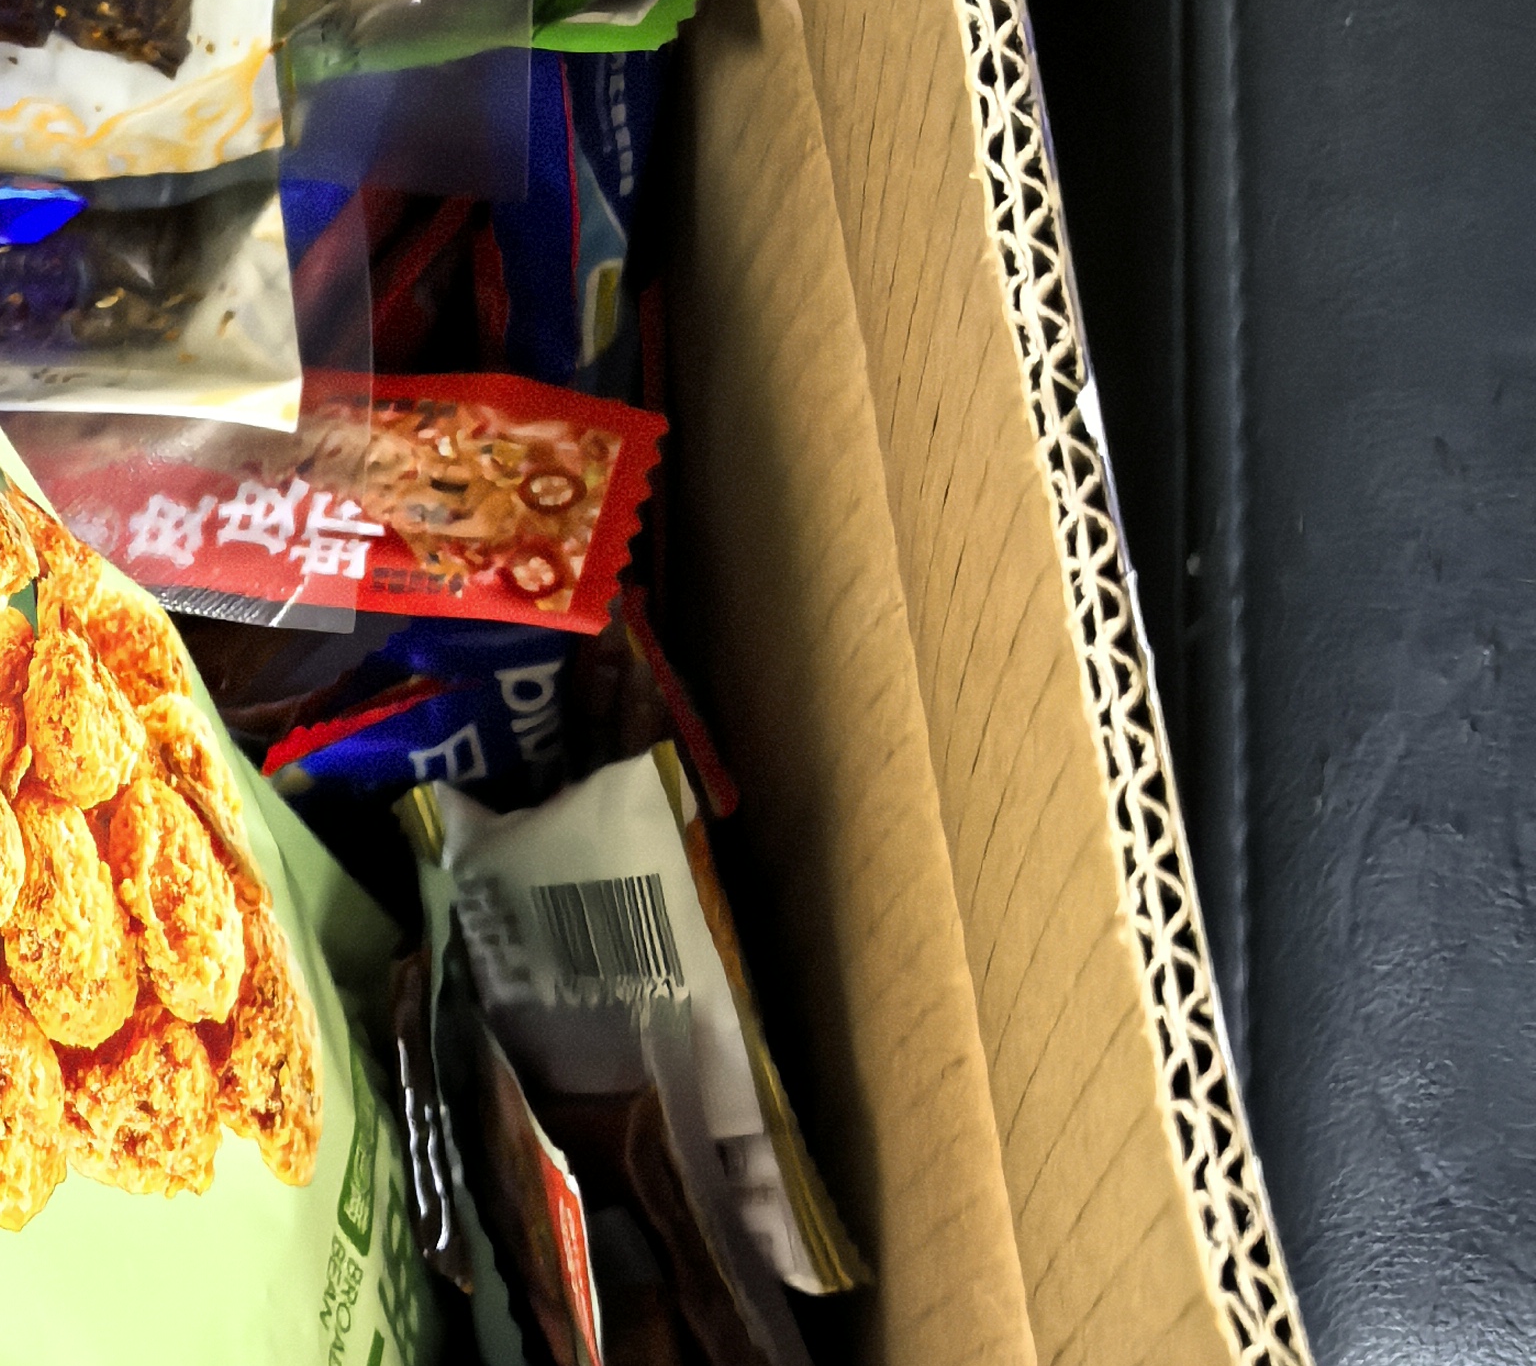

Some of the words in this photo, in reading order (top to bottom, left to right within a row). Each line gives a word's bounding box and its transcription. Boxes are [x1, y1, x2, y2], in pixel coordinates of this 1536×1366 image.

[126, 478, 385, 581] 皮皮虾
[319, 1233, 346, 1331] BEAN
